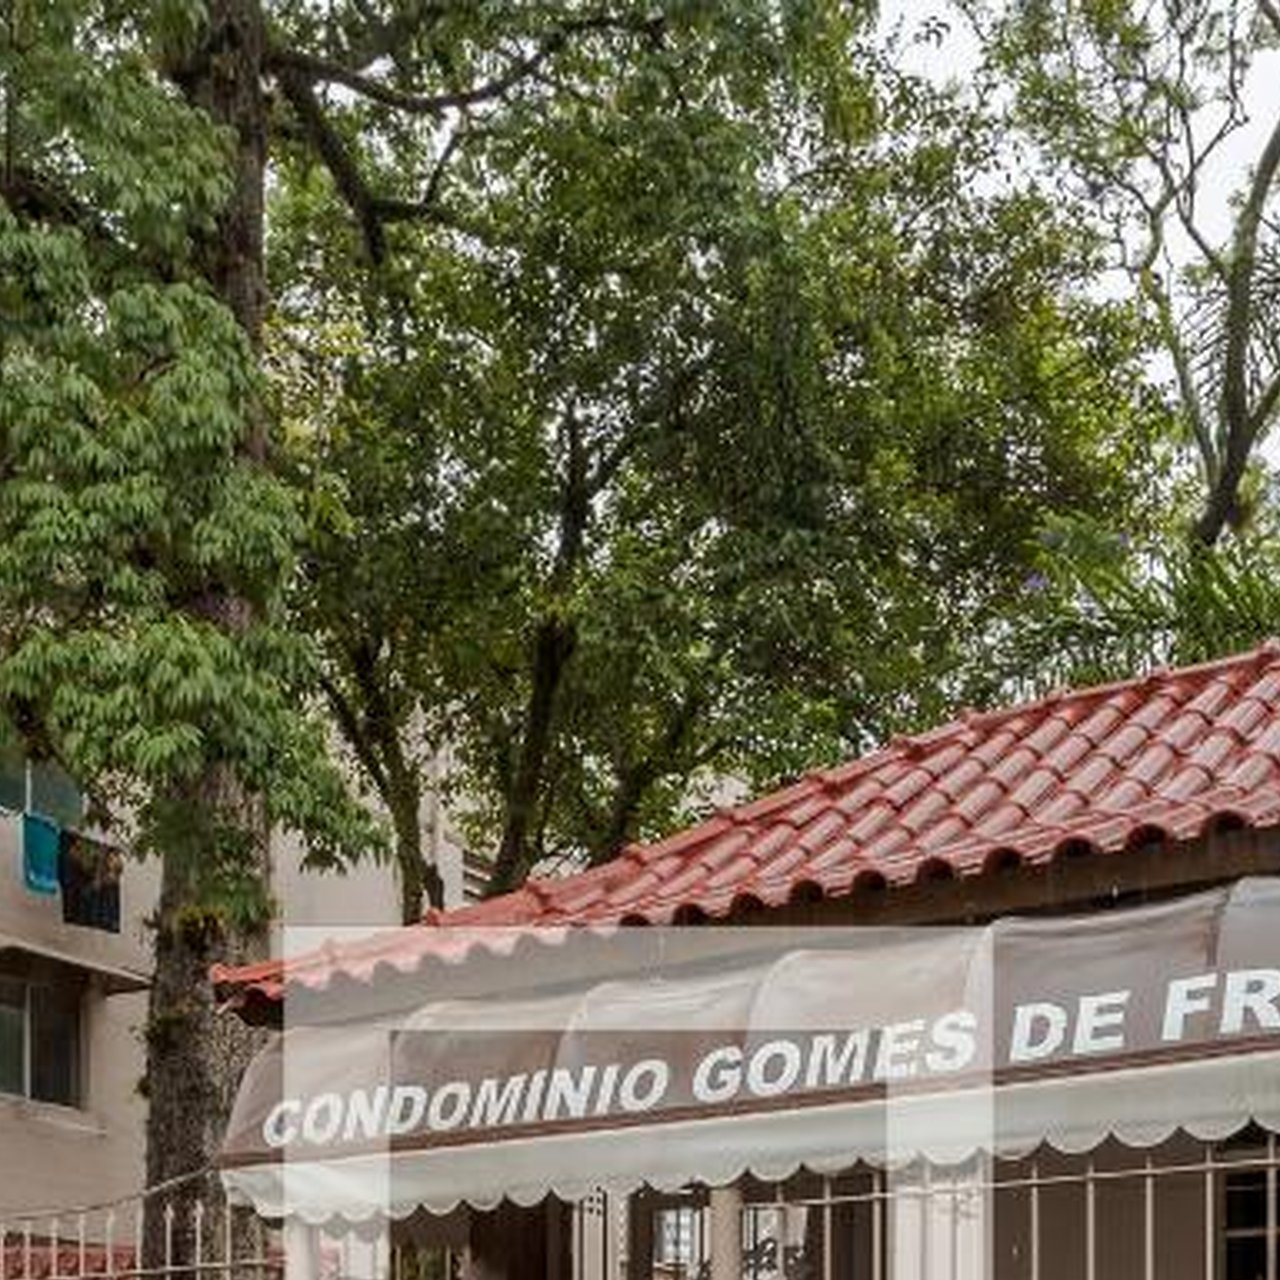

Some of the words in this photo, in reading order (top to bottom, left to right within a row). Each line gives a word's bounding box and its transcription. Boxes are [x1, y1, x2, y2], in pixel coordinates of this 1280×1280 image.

[263, 1059, 669, 1148] CONDOMINIO
[692, 1011, 977, 1102] GOMES
[1009, 991, 1130, 1063] DE
